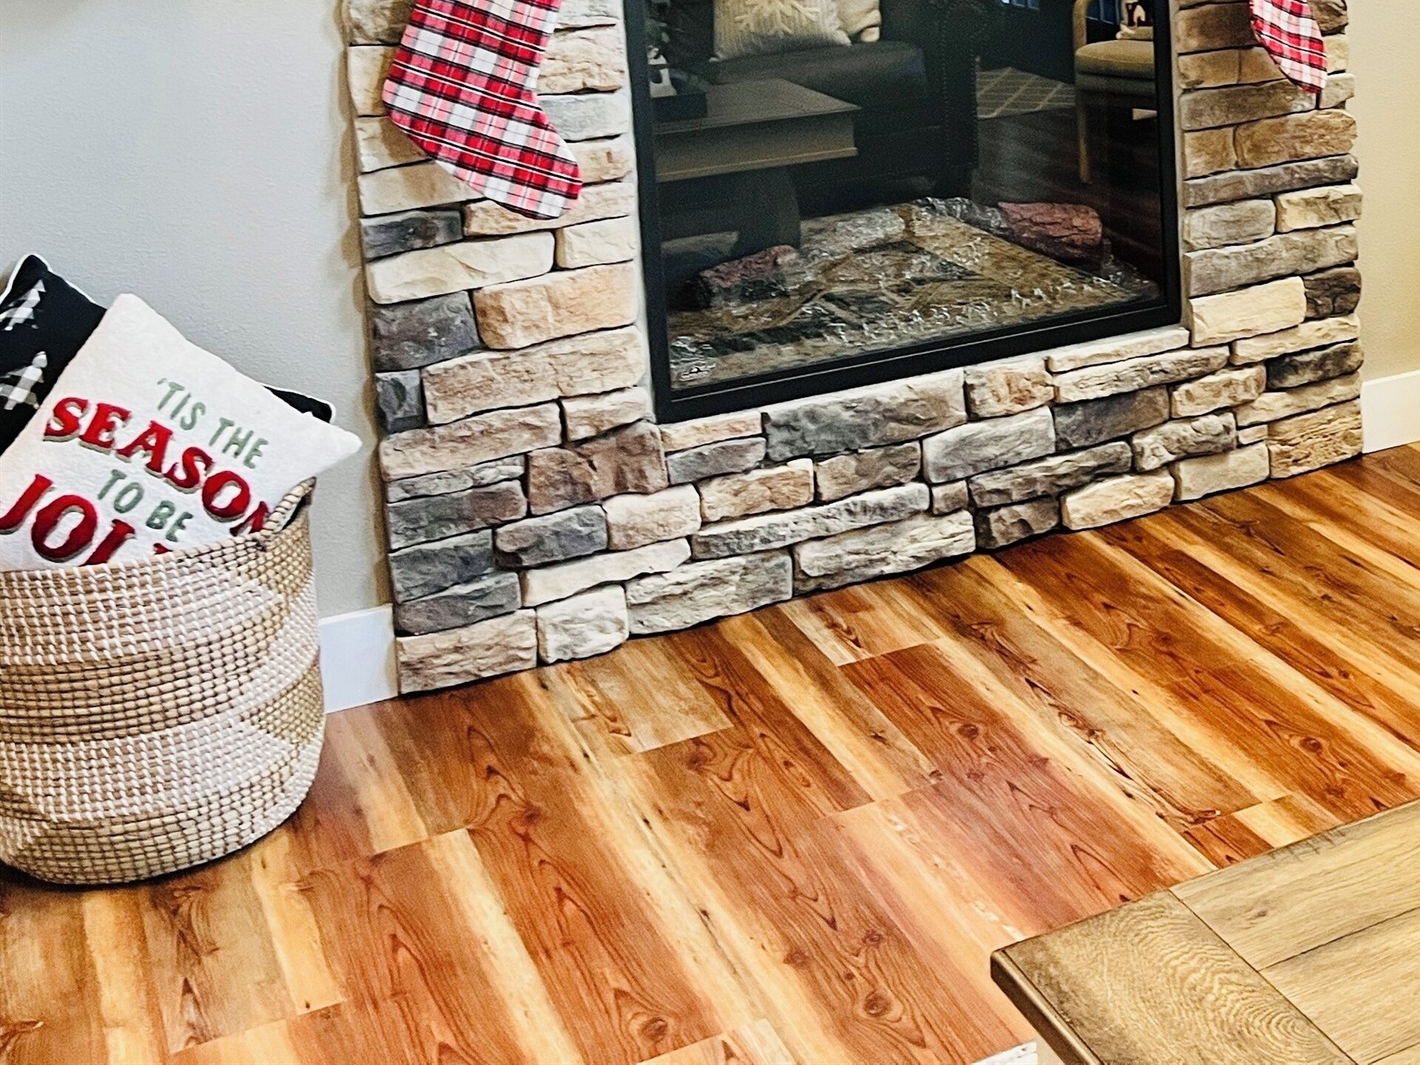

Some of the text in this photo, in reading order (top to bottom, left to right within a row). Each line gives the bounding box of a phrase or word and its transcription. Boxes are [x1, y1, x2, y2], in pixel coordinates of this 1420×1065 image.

[157, 377, 269, 469] 'TIS THE
[97, 469, 195, 542] TO BE
